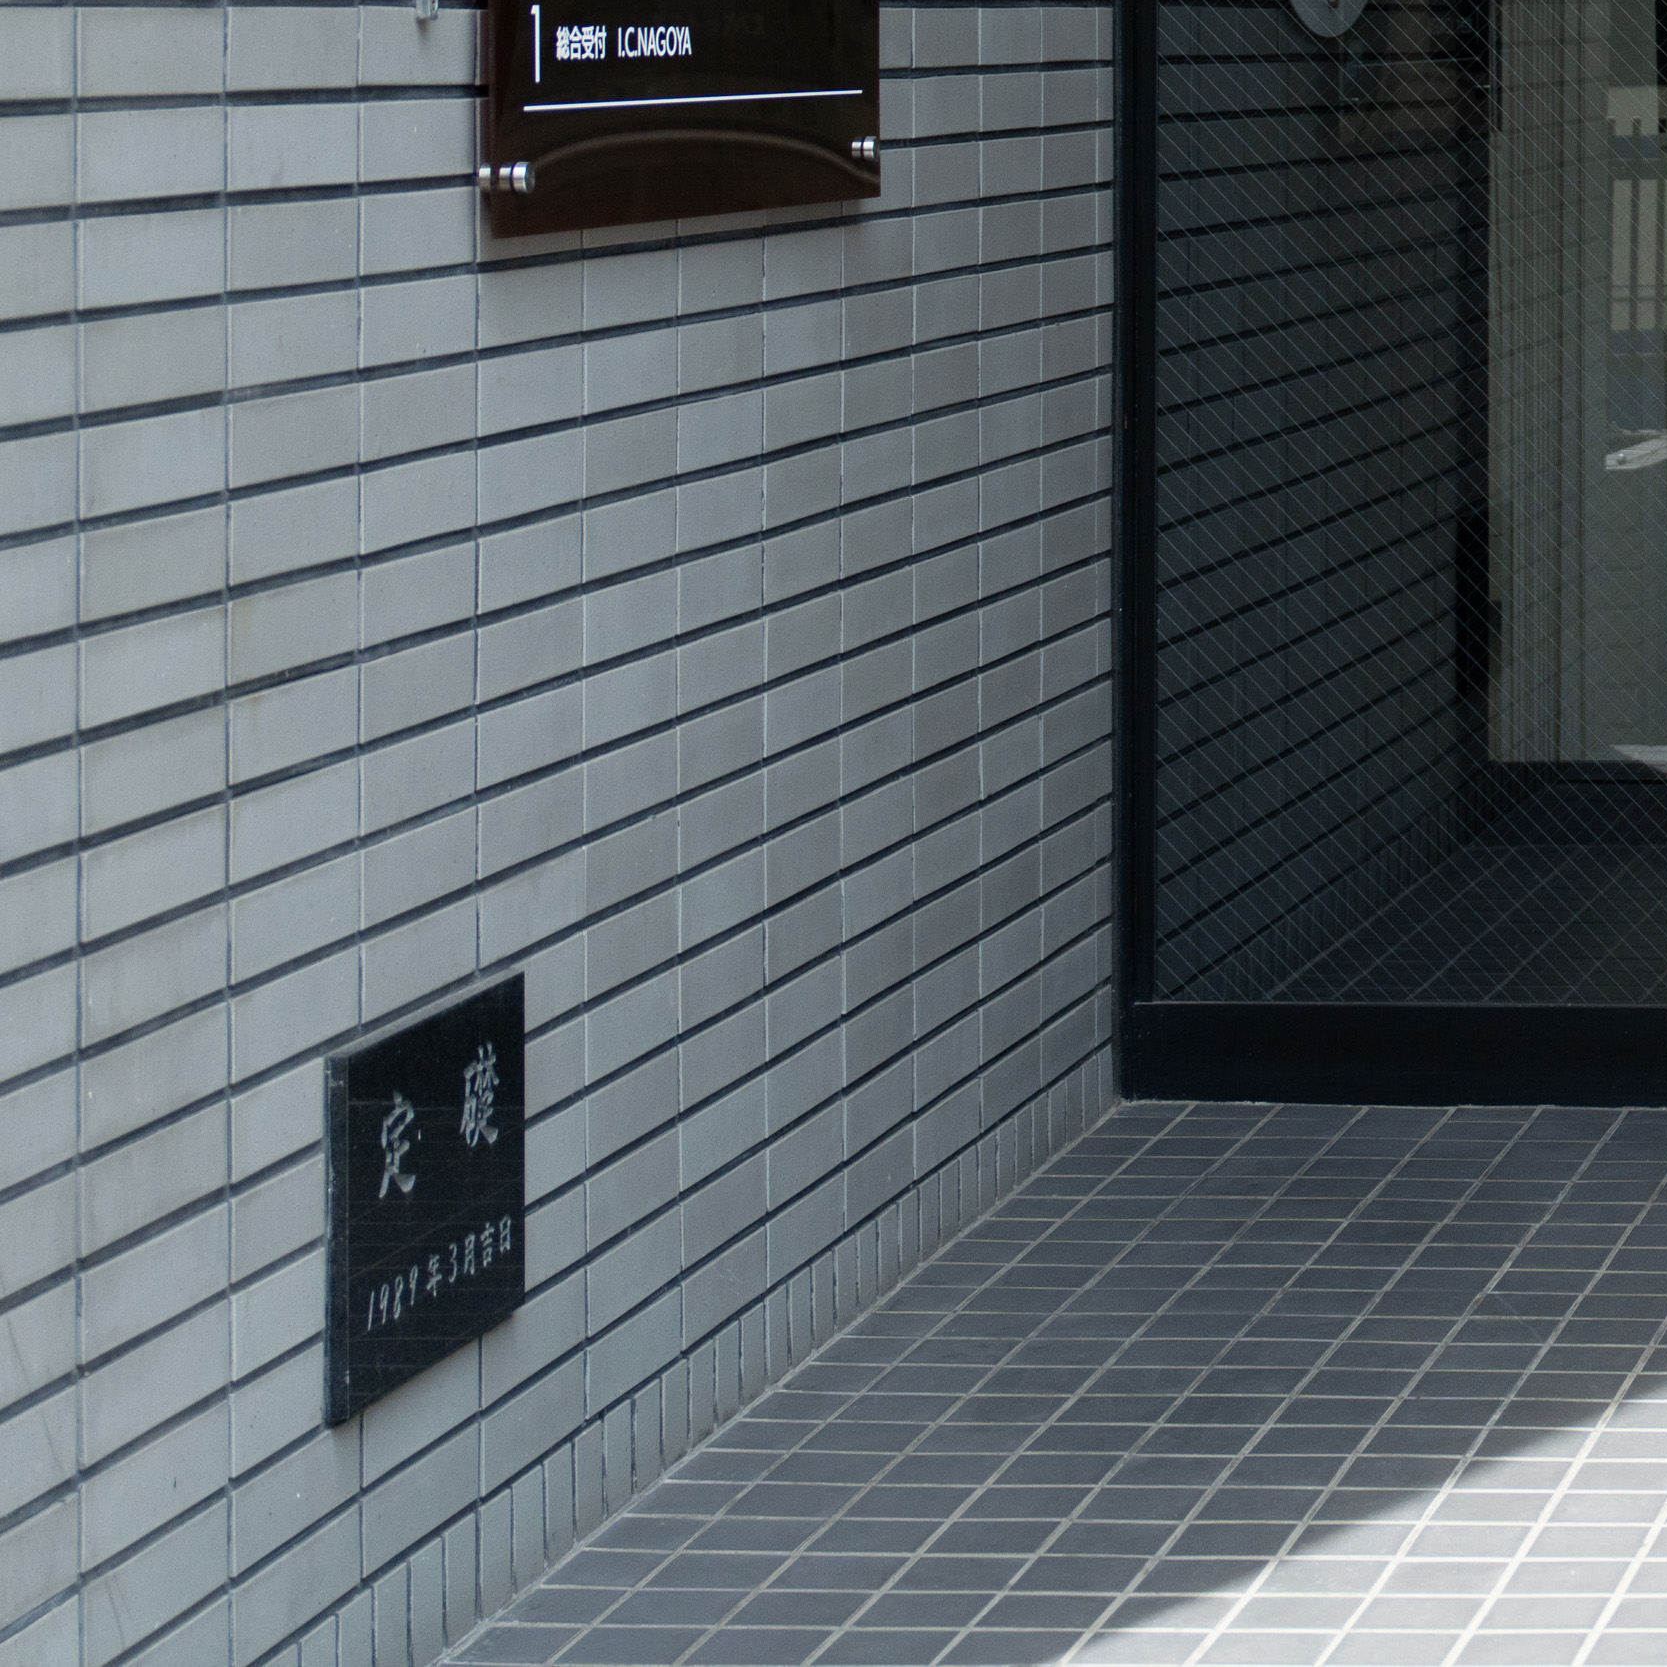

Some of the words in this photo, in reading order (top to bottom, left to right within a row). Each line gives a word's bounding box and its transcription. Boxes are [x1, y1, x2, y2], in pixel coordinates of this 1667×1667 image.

[530, 4, 541, 83] 1
[556, 25, 607, 61] 総合受付
[617, 26, 692, 58] I.C.NAGOYA
[366, 1214, 512, 1332] 1989年3月吉日
